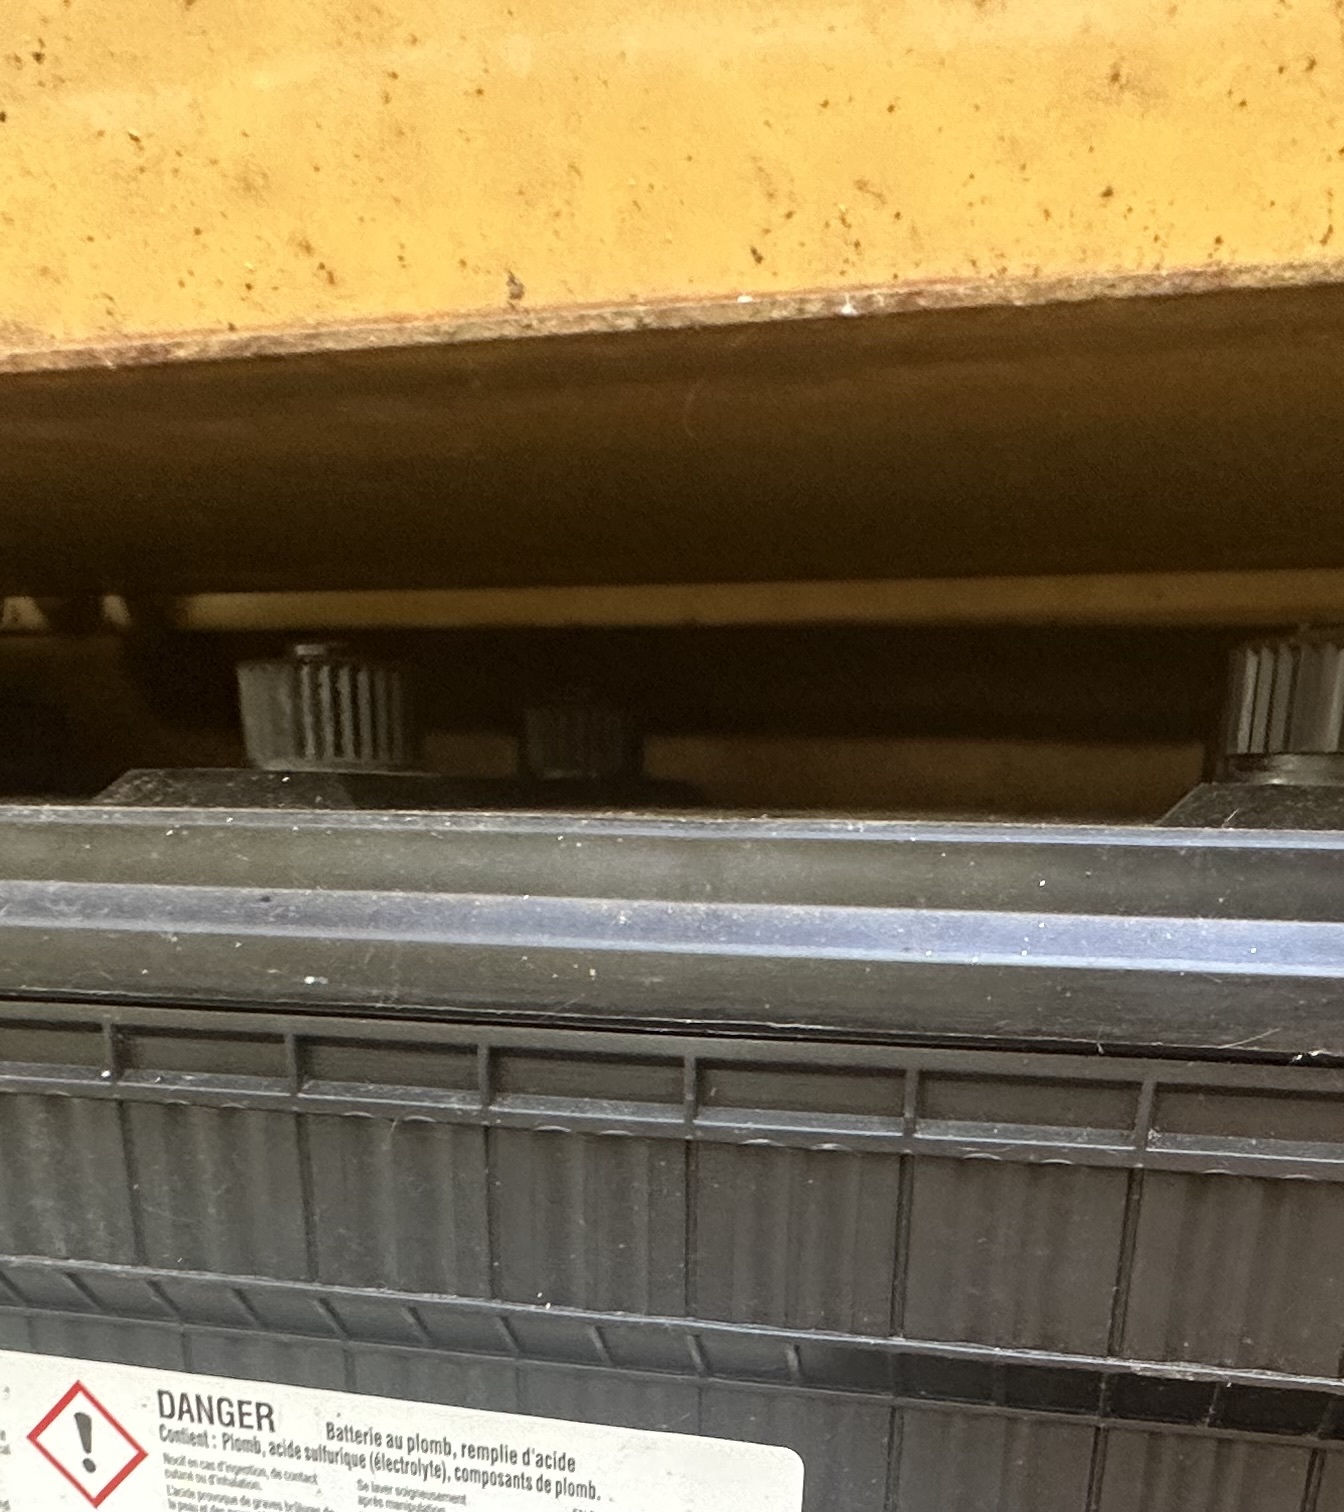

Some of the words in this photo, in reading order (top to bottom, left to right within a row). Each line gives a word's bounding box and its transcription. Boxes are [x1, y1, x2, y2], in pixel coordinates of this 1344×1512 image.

[156, 1389, 276, 1433] DANGER
[222, 1432, 266, 1458] Plomb,
[268, 1439, 302, 1460] acide
[304, 1443, 366, 1471] sulfurique
[369, 1451, 451, 1484] (électrolyte),
[454, 1466, 533, 1491] composants
[535, 1473, 552, 1494] de
[555, 1477, 601, 1501] plomb.
[325, 1421, 382, 1448] Batterie
[386, 1433, 403, 1450] au
[407, 1432, 457, 1460] plomb,
[461, 1443, 518, 1467] remplie
[522, 1447, 576, 1473] d'acide
